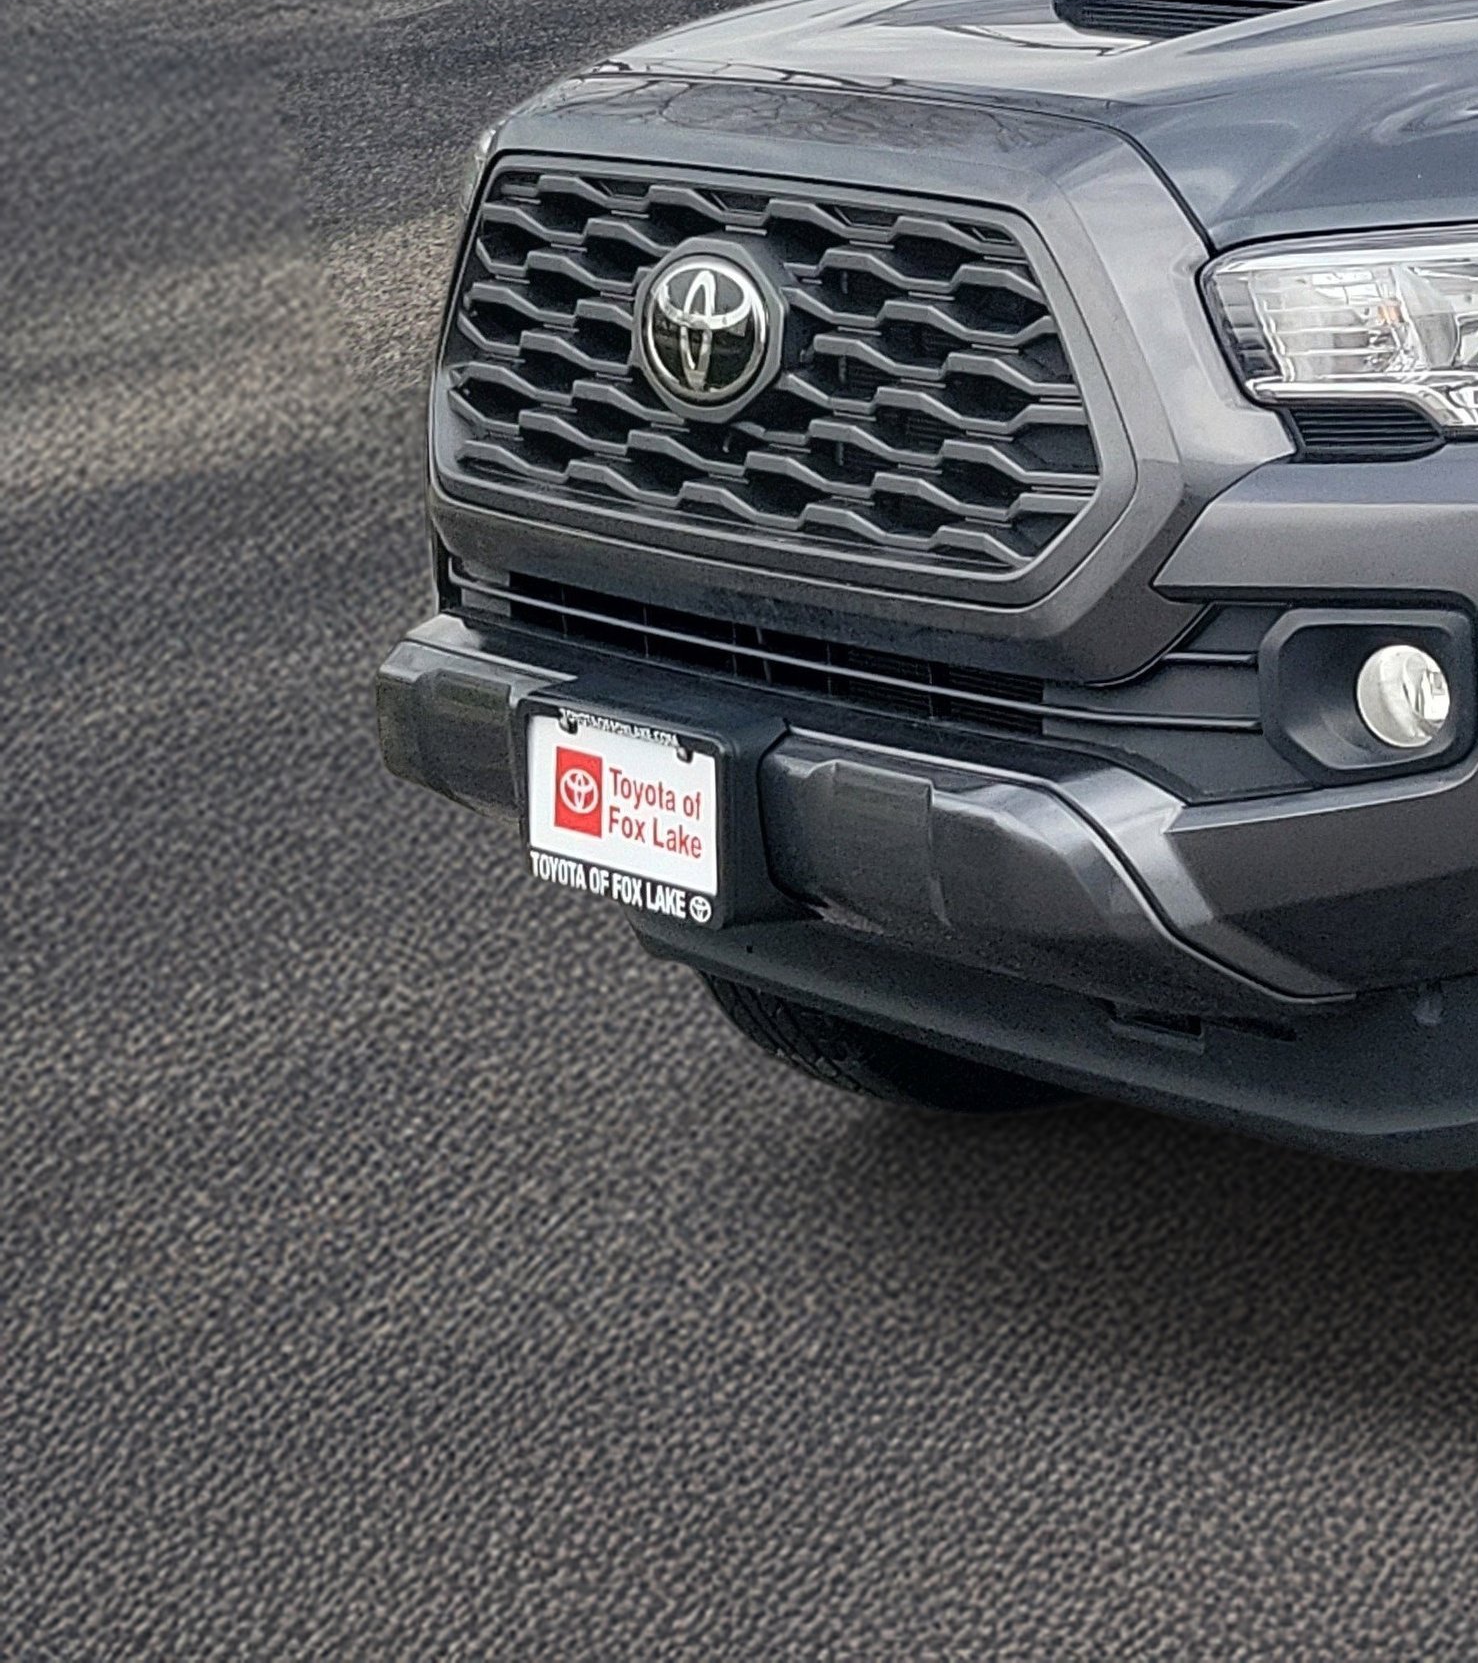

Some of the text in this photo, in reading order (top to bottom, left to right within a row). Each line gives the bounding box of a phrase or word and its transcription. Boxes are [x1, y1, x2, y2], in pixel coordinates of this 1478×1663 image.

[609, 767, 702, 820] Toyota of
[608, 806, 703, 859] Fox Lake
[530, 851, 687, 918] TOYOTA OF FOX LAKE
